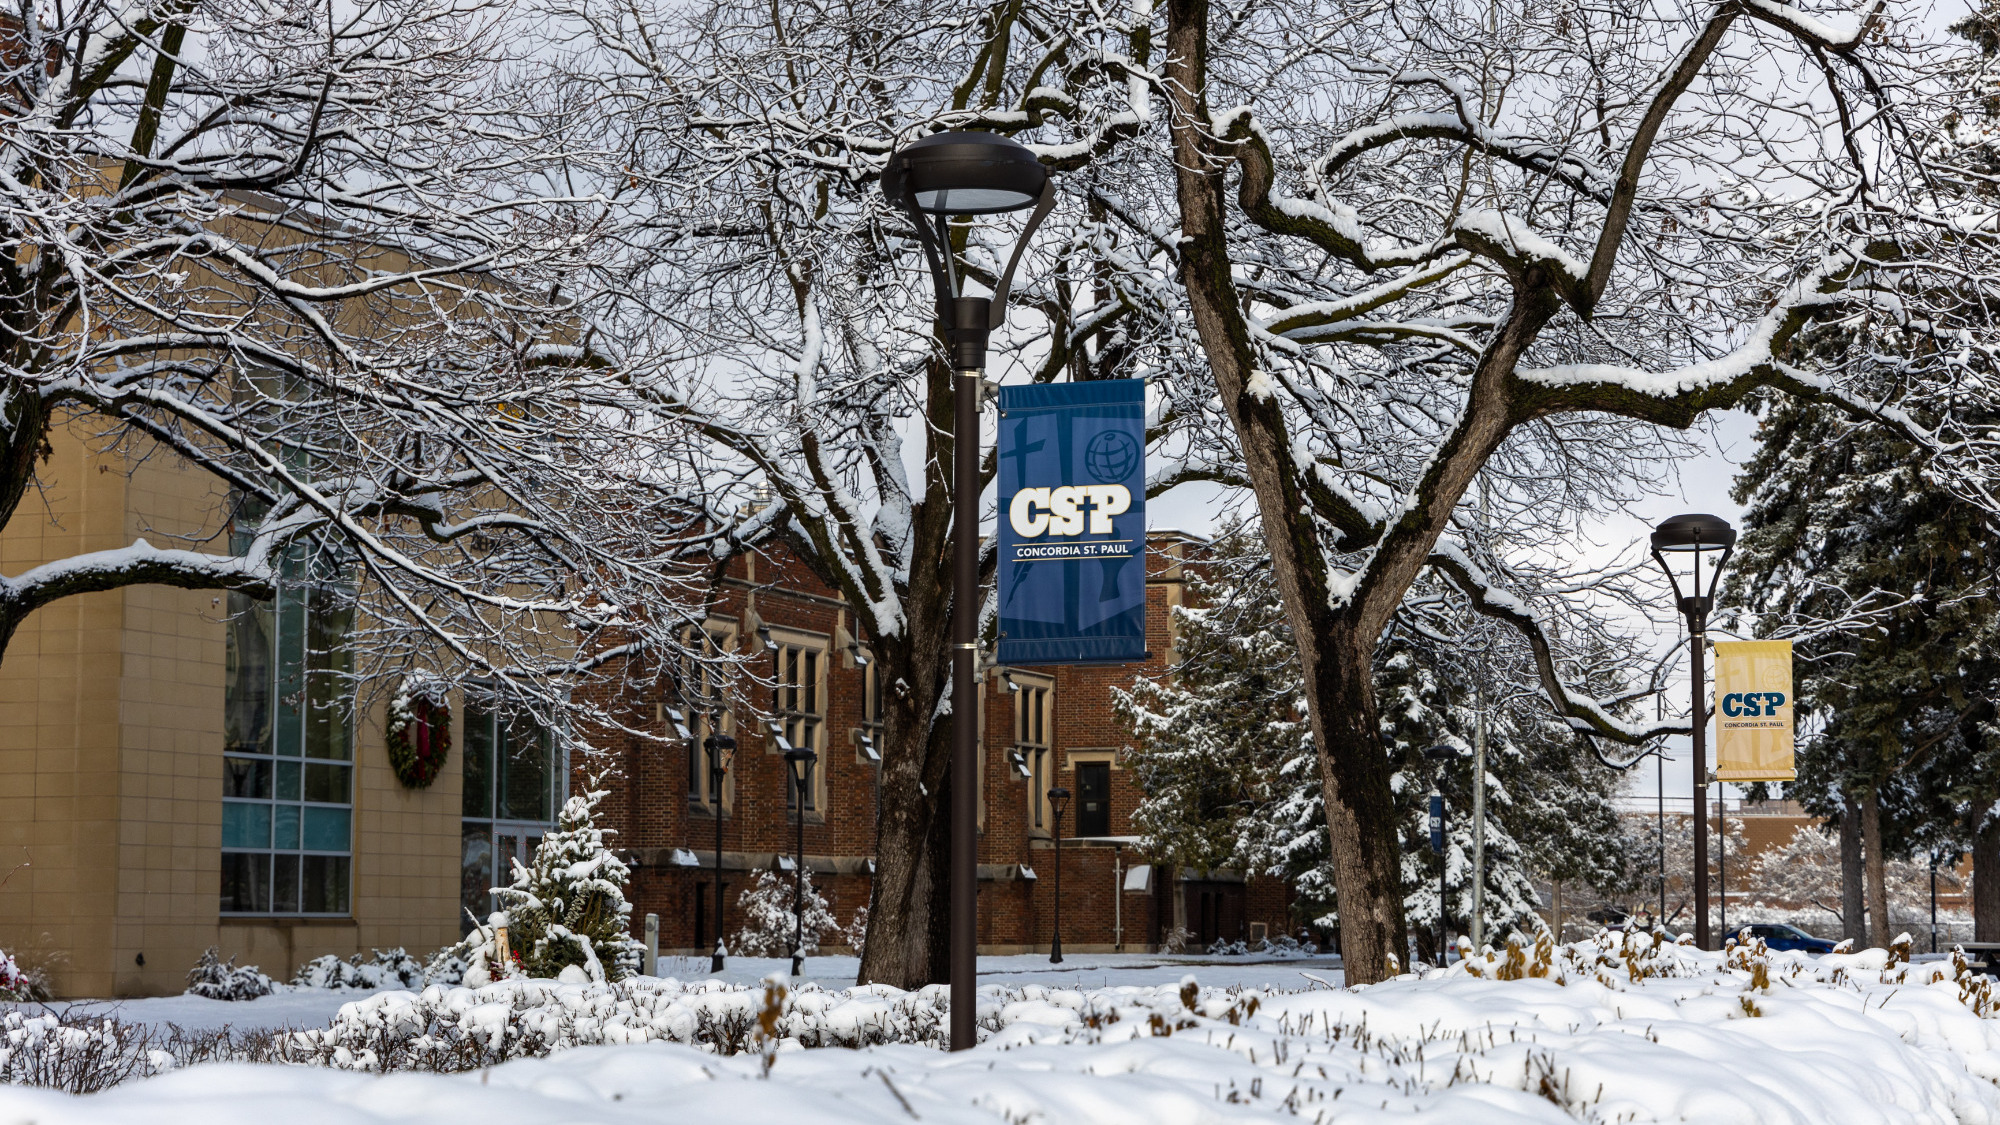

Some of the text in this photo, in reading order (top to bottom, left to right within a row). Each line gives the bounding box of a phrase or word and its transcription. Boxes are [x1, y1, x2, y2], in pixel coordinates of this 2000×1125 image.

[1009, 484, 1131, 538] CSP
[1016, 544, 1129, 557] CONCORDIA ST. PAUL
[1722, 692, 1786, 717] CSP
